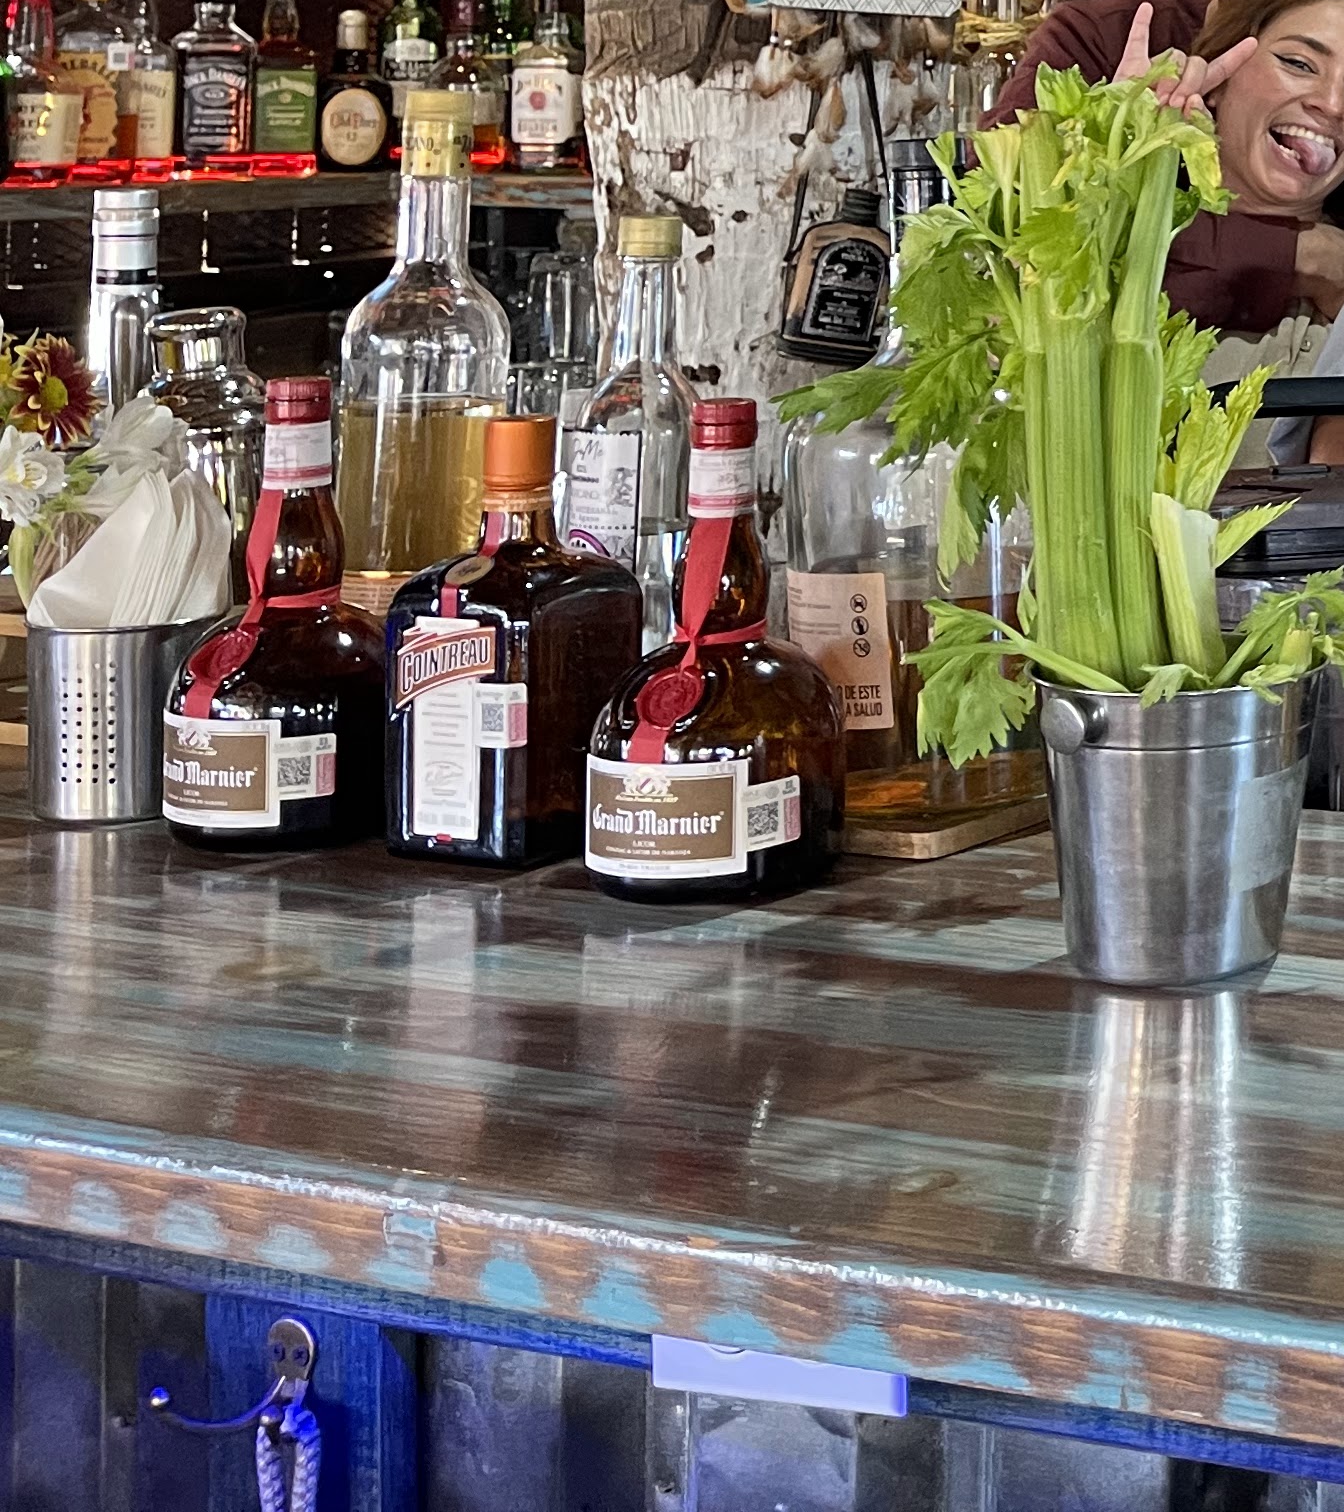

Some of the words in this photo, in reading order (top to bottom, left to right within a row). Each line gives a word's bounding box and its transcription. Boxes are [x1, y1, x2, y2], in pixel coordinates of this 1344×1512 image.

[401, 636, 491, 696] COINTREAU
[845, 685, 856, 699] DE
[858, 685, 881, 699] ESTE
[854, 702, 883, 717] SALUD
[186, 759, 257, 788] Marnier
[592, 803, 634, 835] Grand
[634, 808, 723, 836] Marnier
